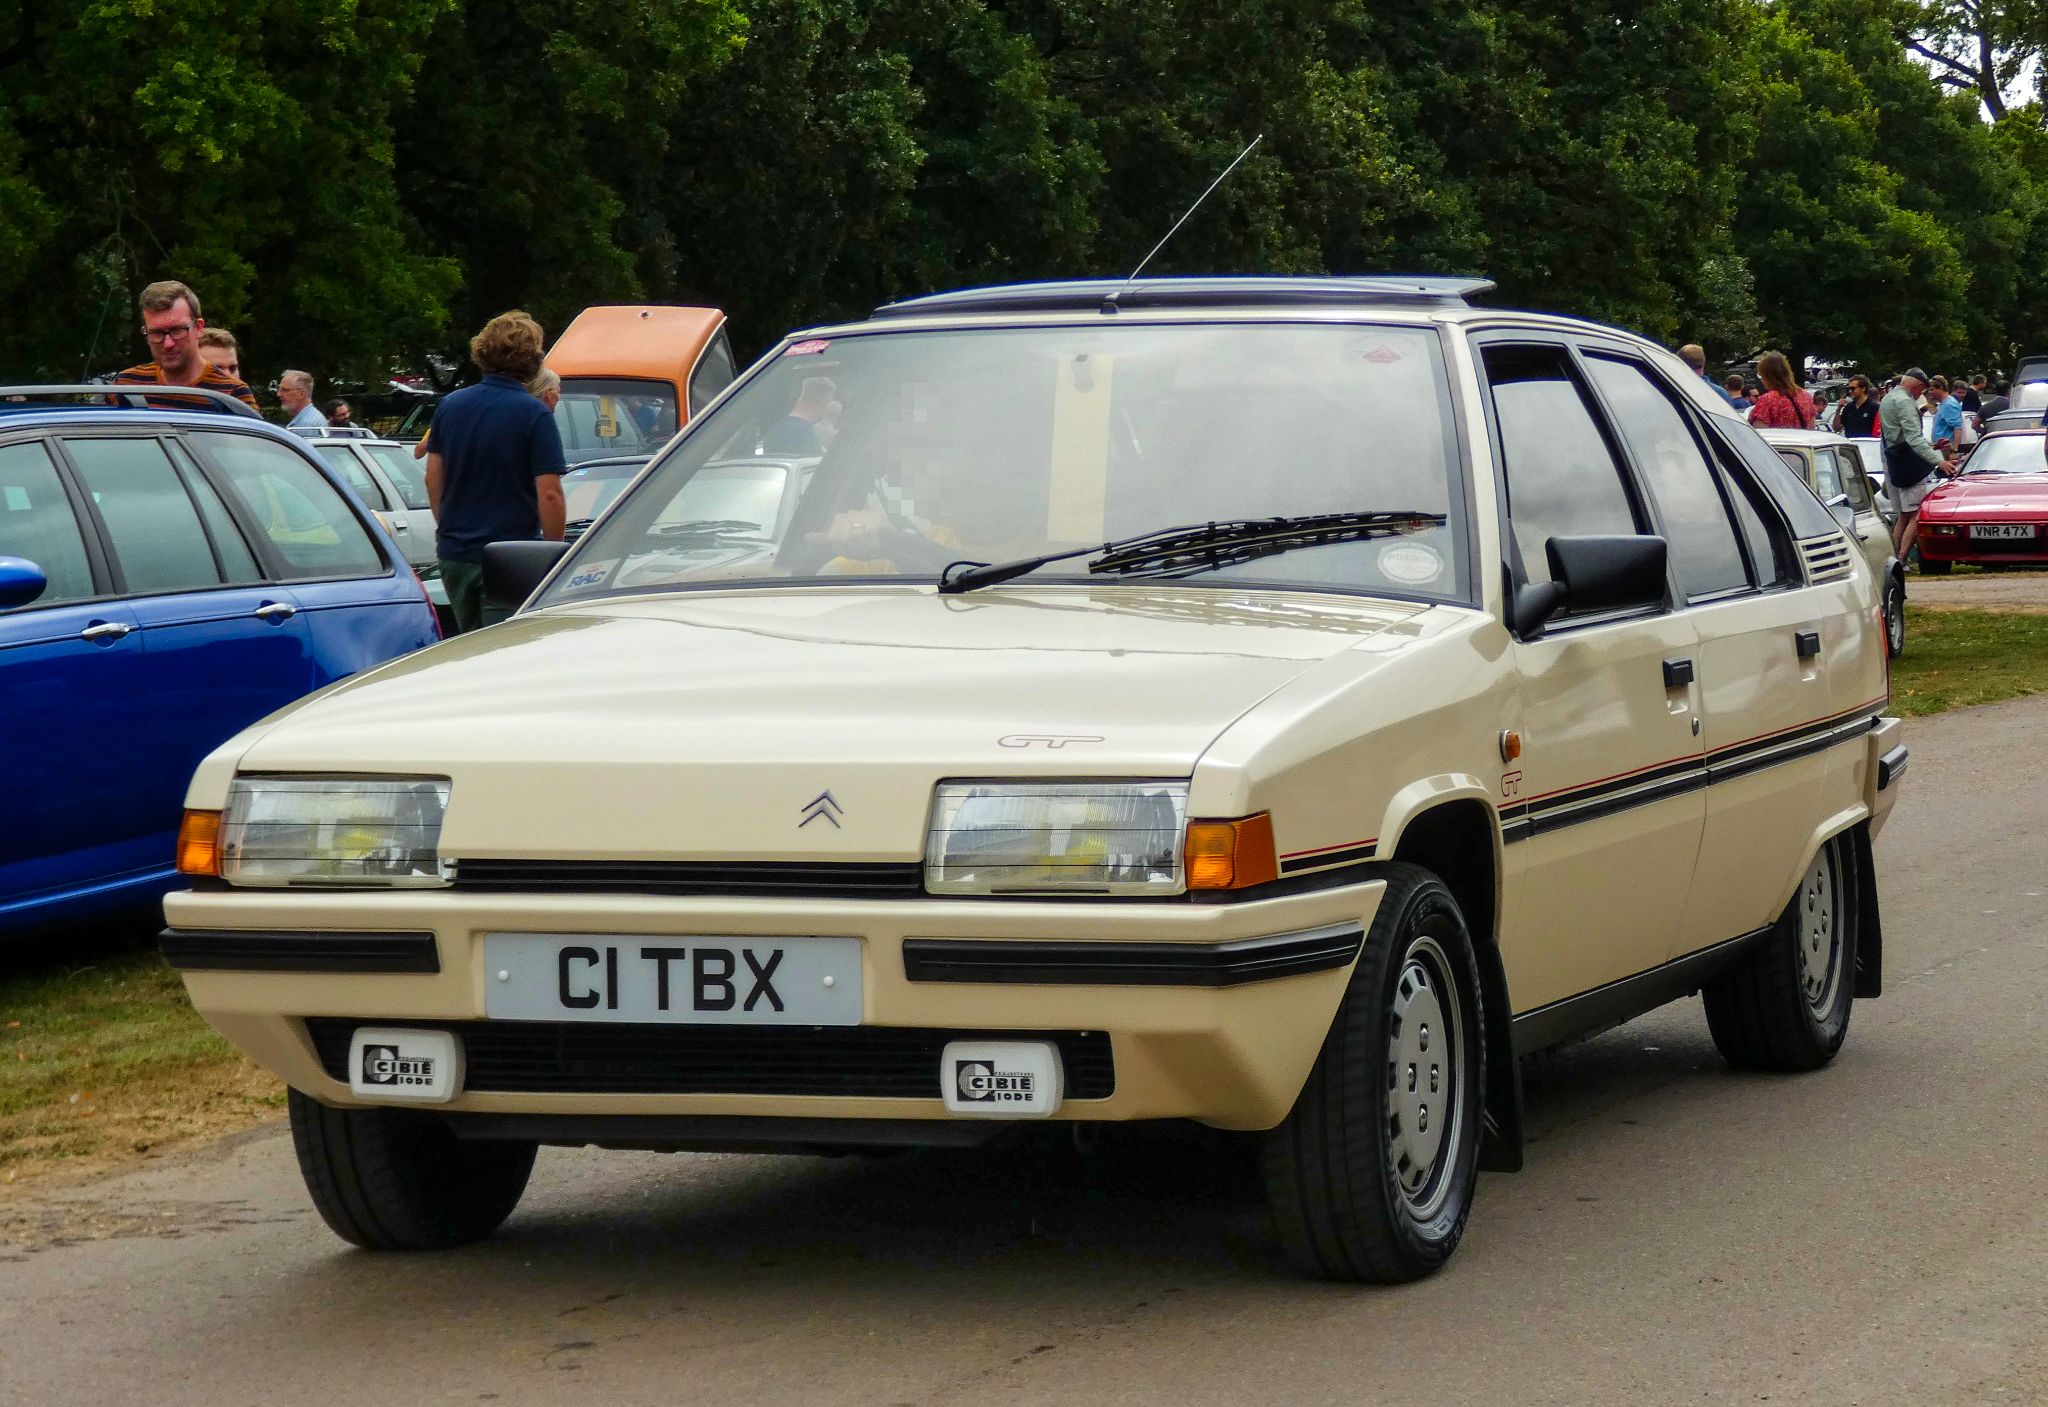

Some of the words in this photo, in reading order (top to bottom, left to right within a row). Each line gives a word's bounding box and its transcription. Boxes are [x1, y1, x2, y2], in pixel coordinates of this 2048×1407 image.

[1975, 526, 2000, 537] VNR
[2003, 525, 2029, 537] 47X
[997, 734, 1105, 749] GT
[1500, 769, 1523, 798] GT
[640, 947, 785, 1012] TBX
[400, 1077, 432, 1086] IODE
[997, 1092, 1033, 1101] IODE
